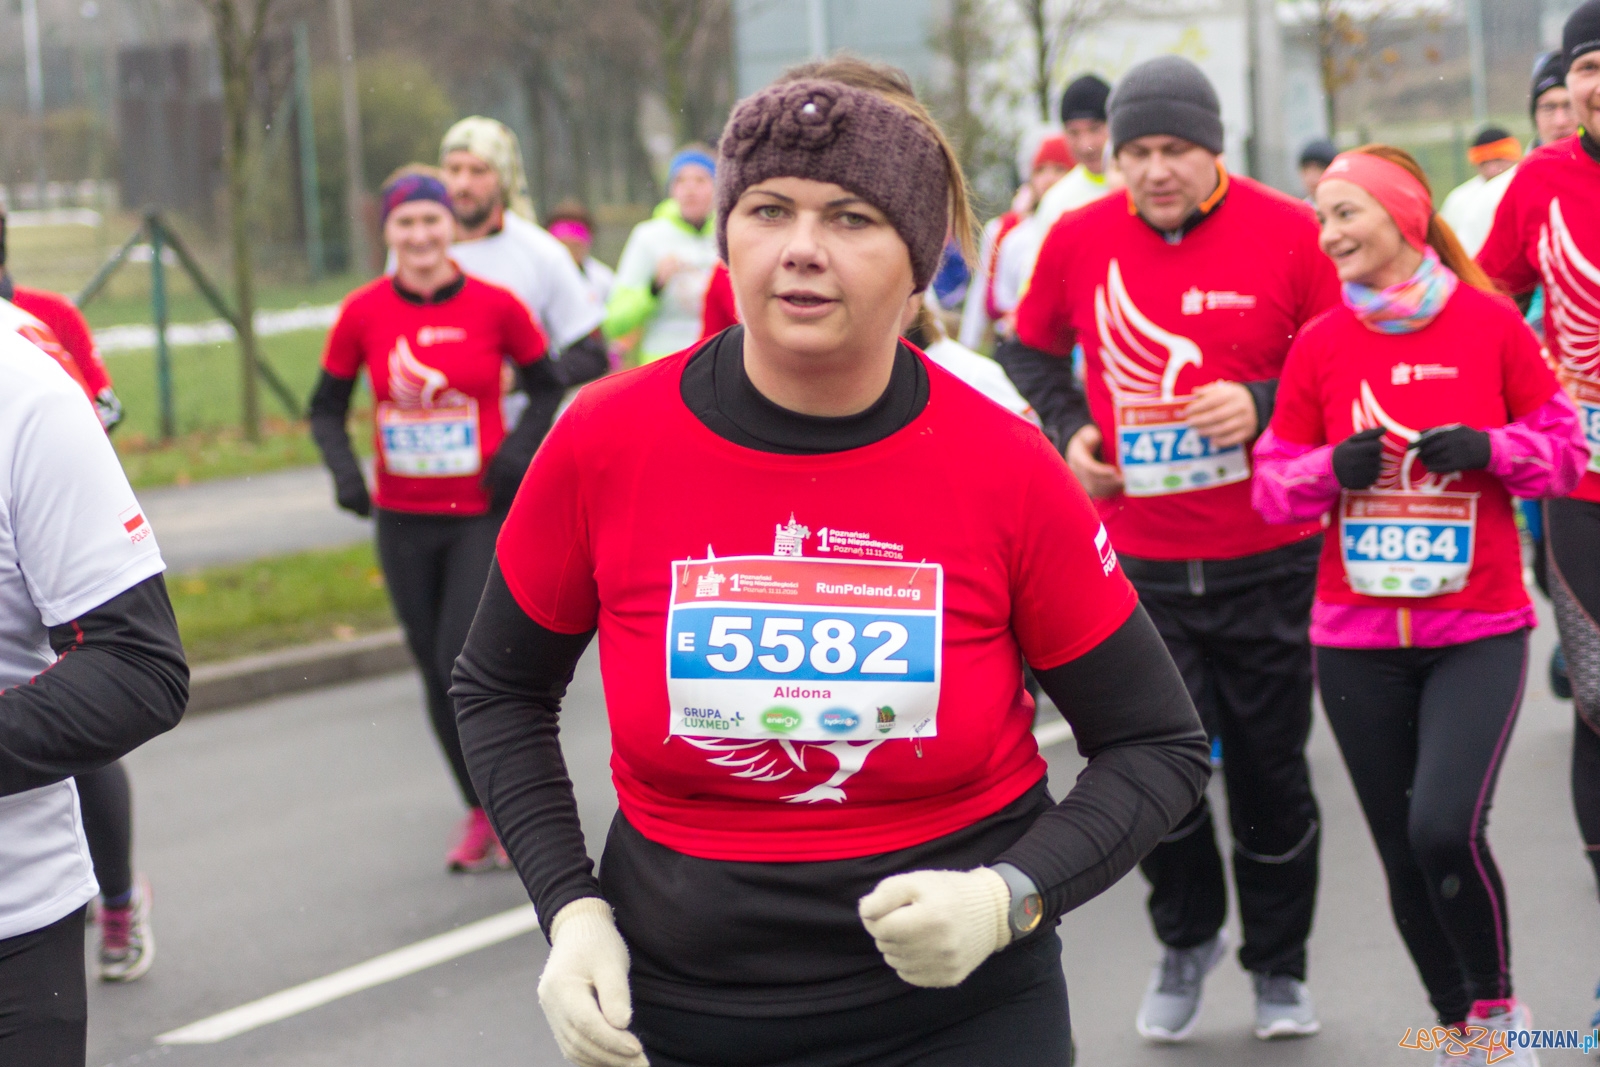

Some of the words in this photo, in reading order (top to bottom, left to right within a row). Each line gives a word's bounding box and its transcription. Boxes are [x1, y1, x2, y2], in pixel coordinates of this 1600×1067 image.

[1131, 427, 1219, 463] 474
[817, 527, 830, 552] 1
[829, 529, 870, 540] Poznański
[829, 536, 847, 546] Bieg
[847, 537, 903, 552] Niepodległości
[1355, 526, 1459, 562] 4864
[865, 548, 903, 560] 11.11.2016
[730, 573, 741, 592] 1
[740, 579, 754, 587] Bieg
[816, 582, 921, 601] RunPoland.org
[677, 632, 696, 652] E
[705, 615, 909, 674] 5582
[773, 686, 832, 699] Aldona
[684, 707, 722, 719] GRUPA
[684, 718, 730, 731] LUXMED
